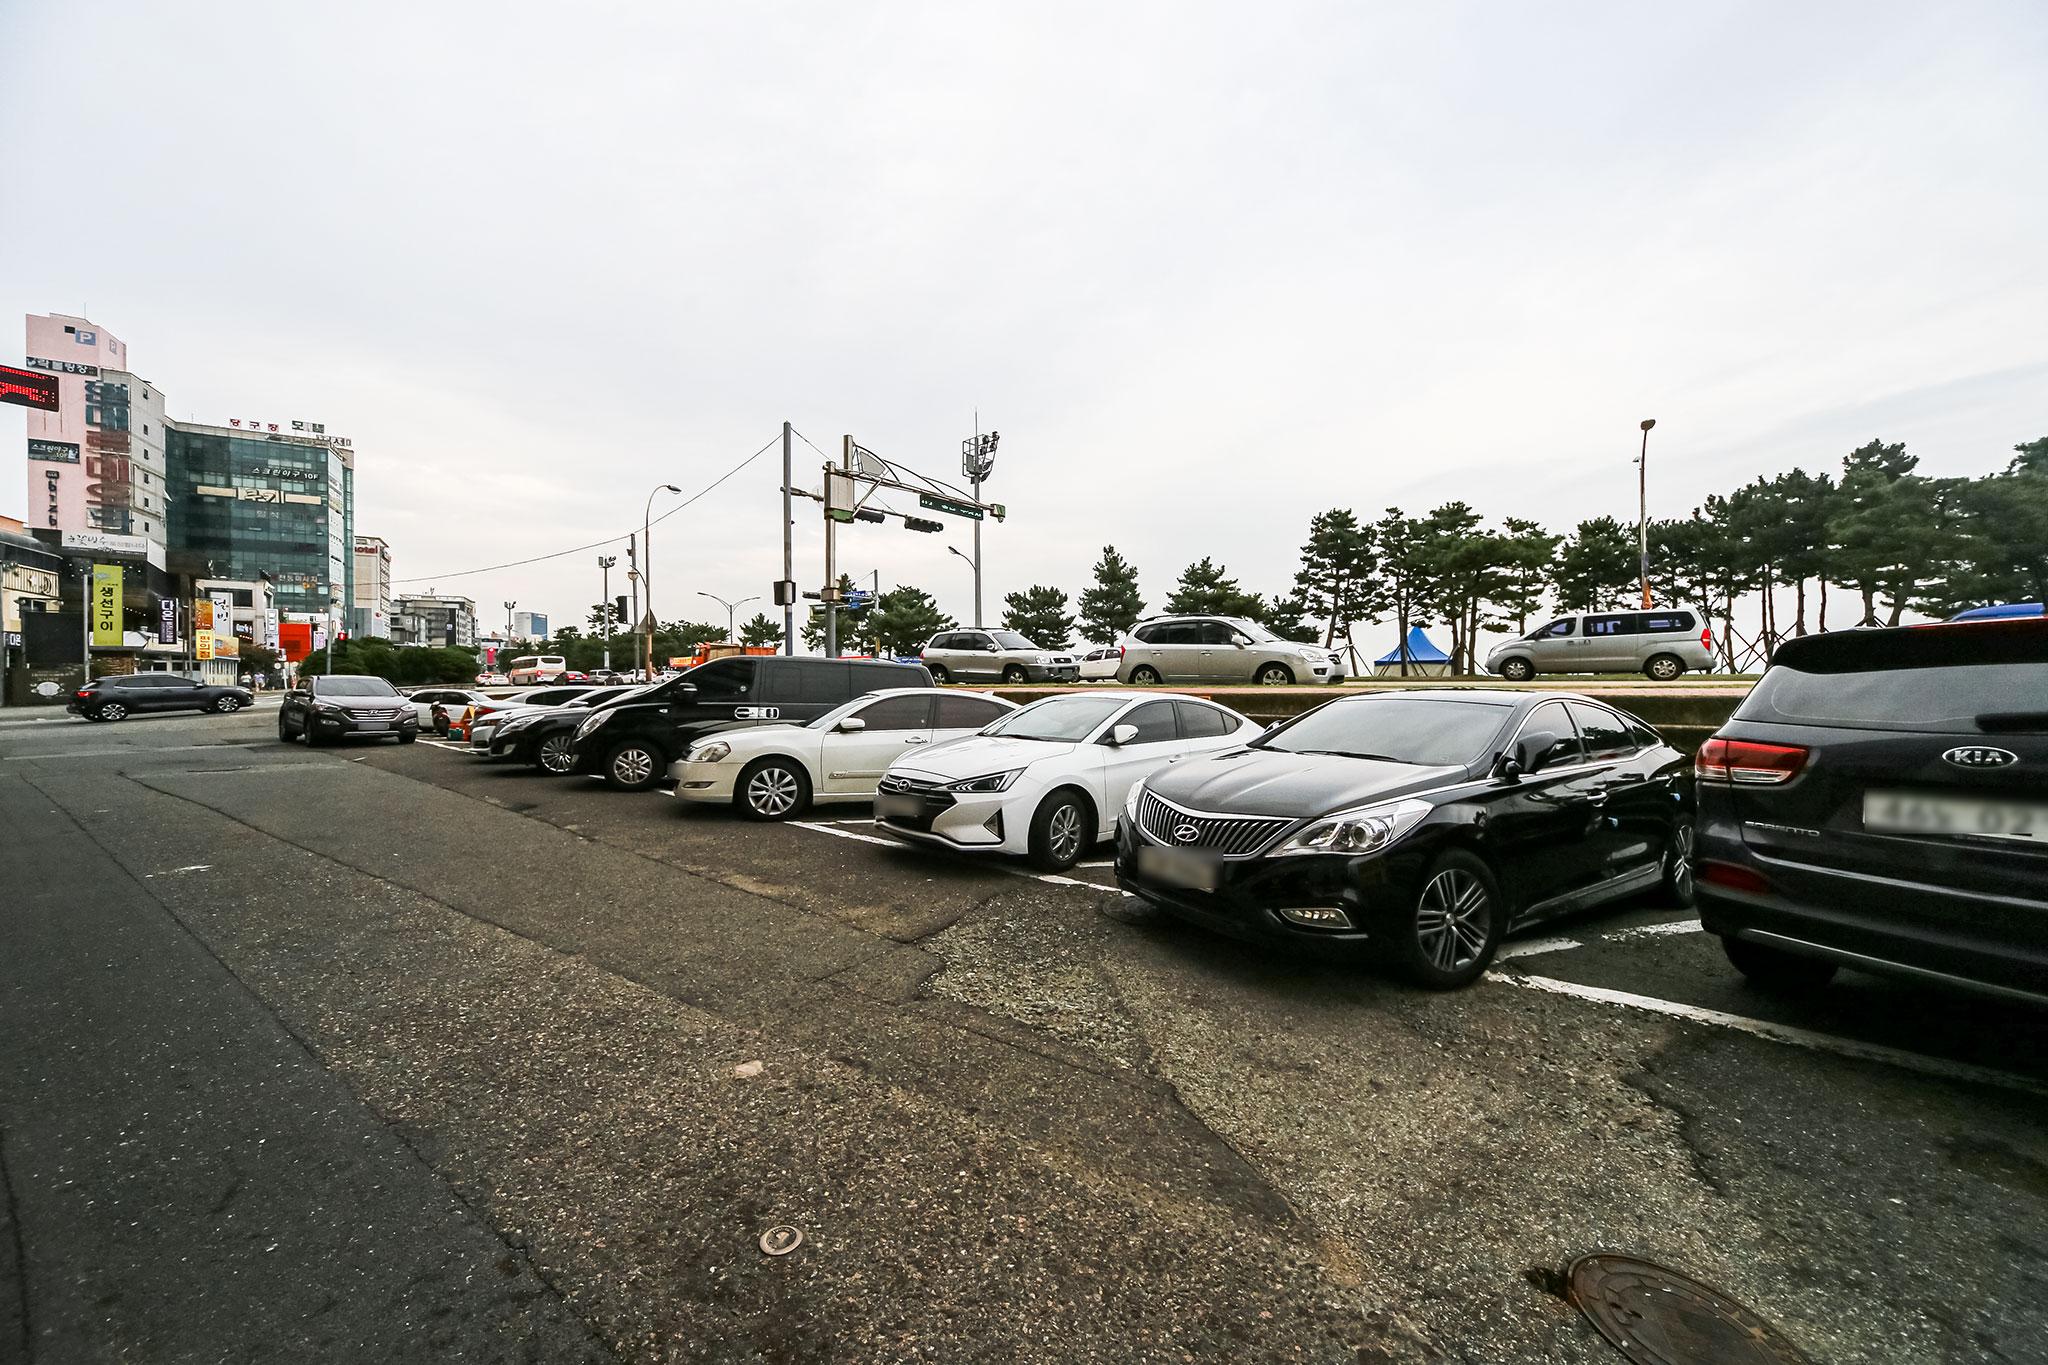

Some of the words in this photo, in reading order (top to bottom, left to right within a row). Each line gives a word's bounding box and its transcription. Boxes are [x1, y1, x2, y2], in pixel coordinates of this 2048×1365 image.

[80, 332, 92, 343] P
[99, 587, 114, 631] 생선구이
[1954, 750, 2004, 763] KIA
